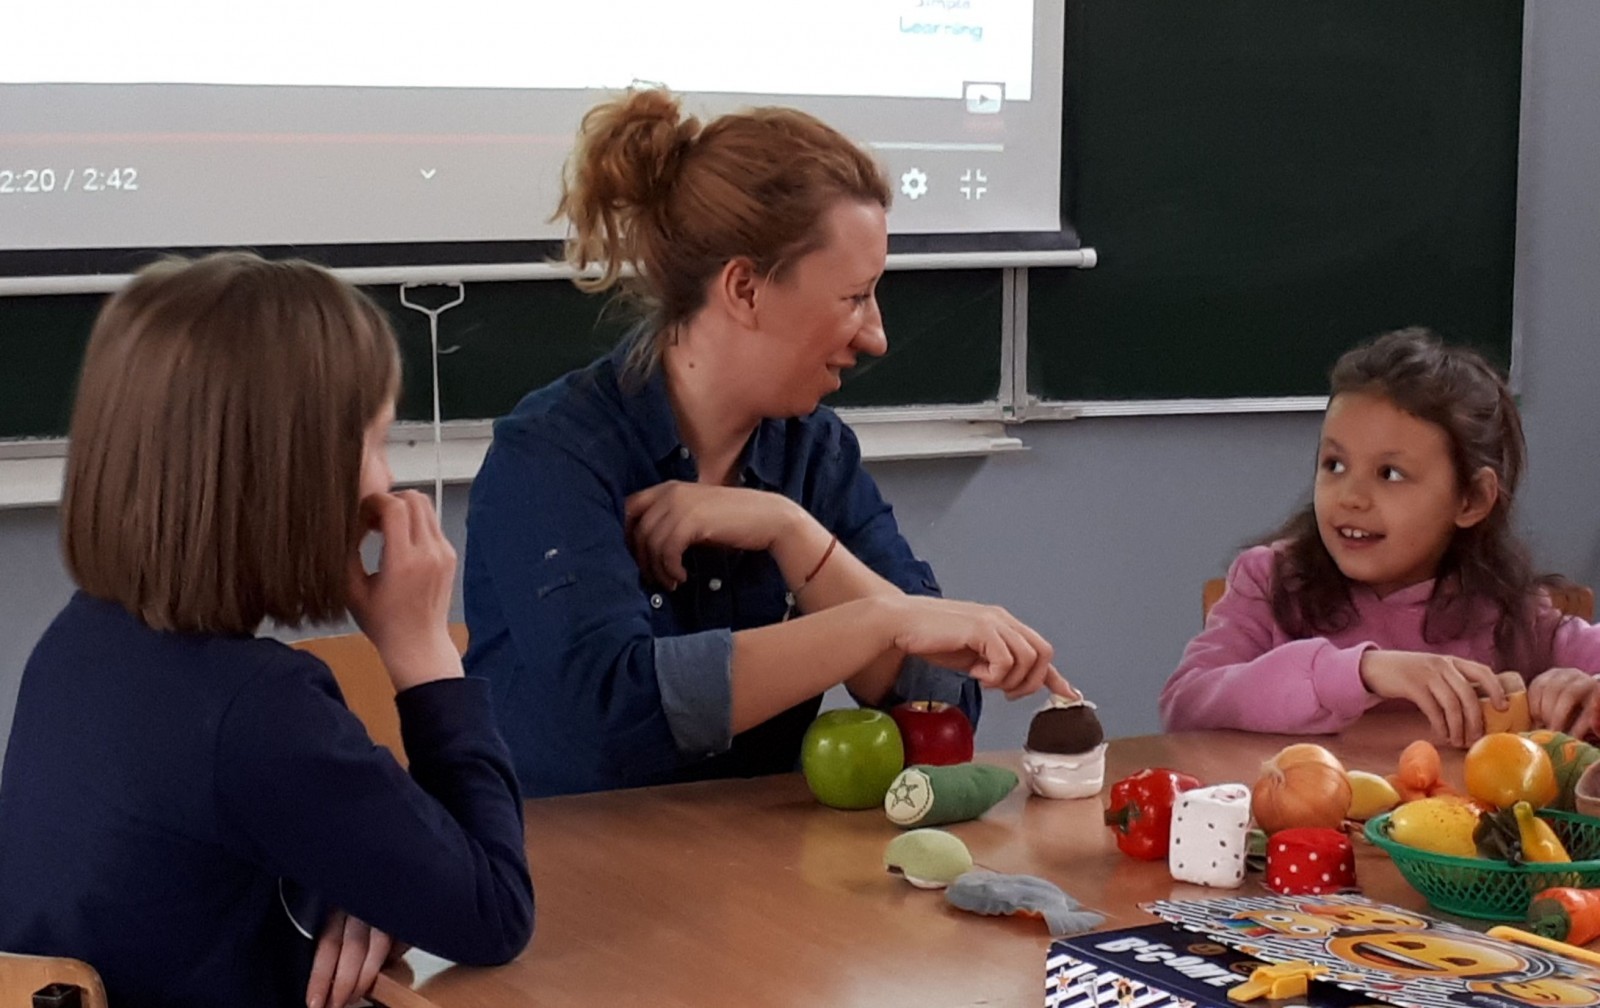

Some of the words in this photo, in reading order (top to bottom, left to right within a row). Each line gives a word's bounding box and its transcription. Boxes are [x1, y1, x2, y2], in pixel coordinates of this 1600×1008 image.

[899, 16, 984, 41] Learning
[0, 169, 56, 193] 2:20
[63, 168, 75, 192] /
[82, 167, 138, 191] 2:42
